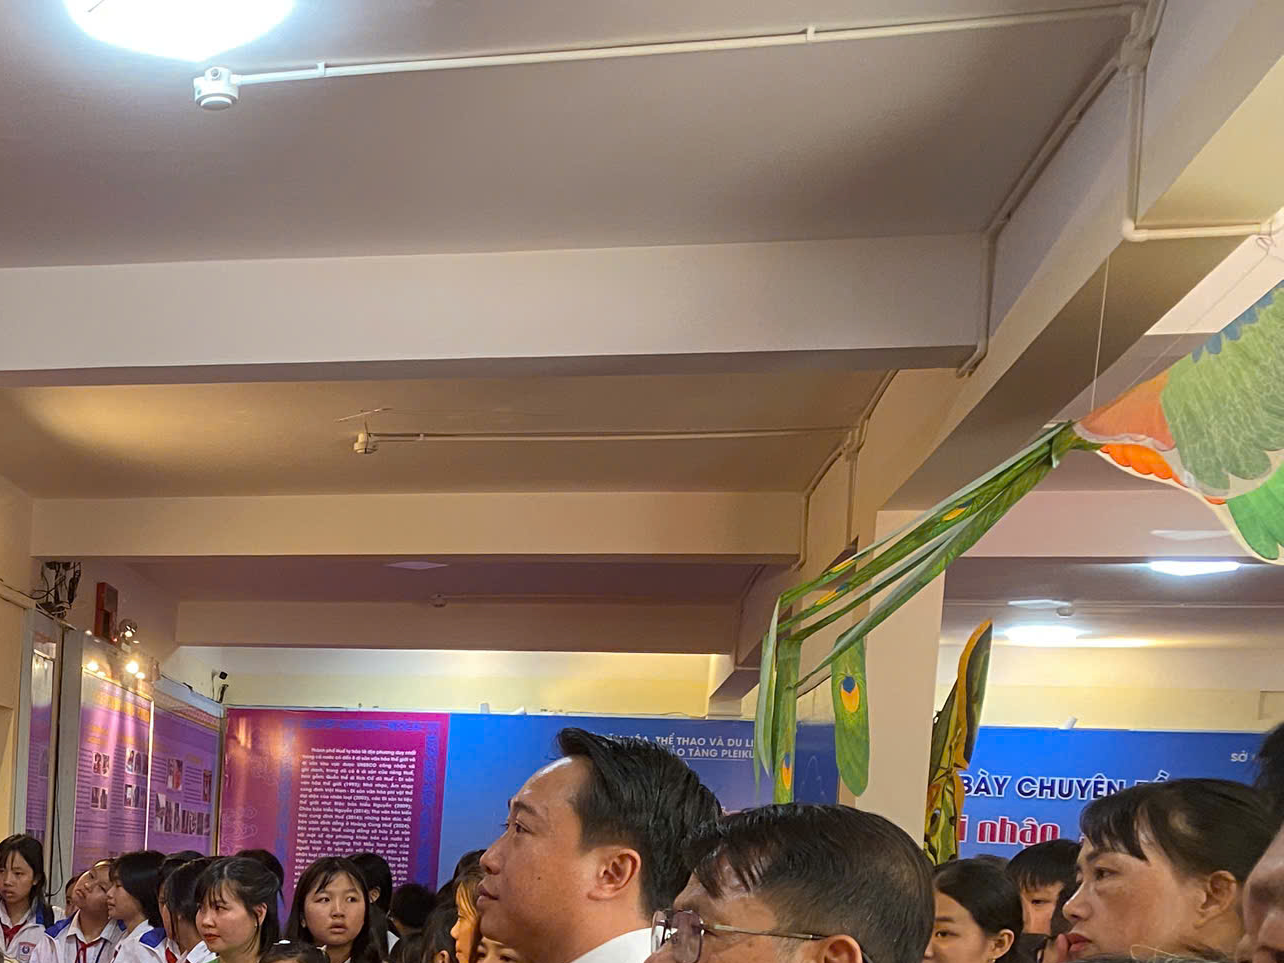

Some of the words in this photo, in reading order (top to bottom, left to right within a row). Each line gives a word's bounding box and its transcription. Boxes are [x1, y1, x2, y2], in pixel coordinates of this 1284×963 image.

[676, 736, 706, 746] THAO
[709, 735, 724, 746] VÀ
[727, 738, 742, 747] DU
[688, 745, 717, 758] TÀNG
[959, 768, 1012, 798] BÀY
[1016, 772, 1126, 800] CHUYÊN
